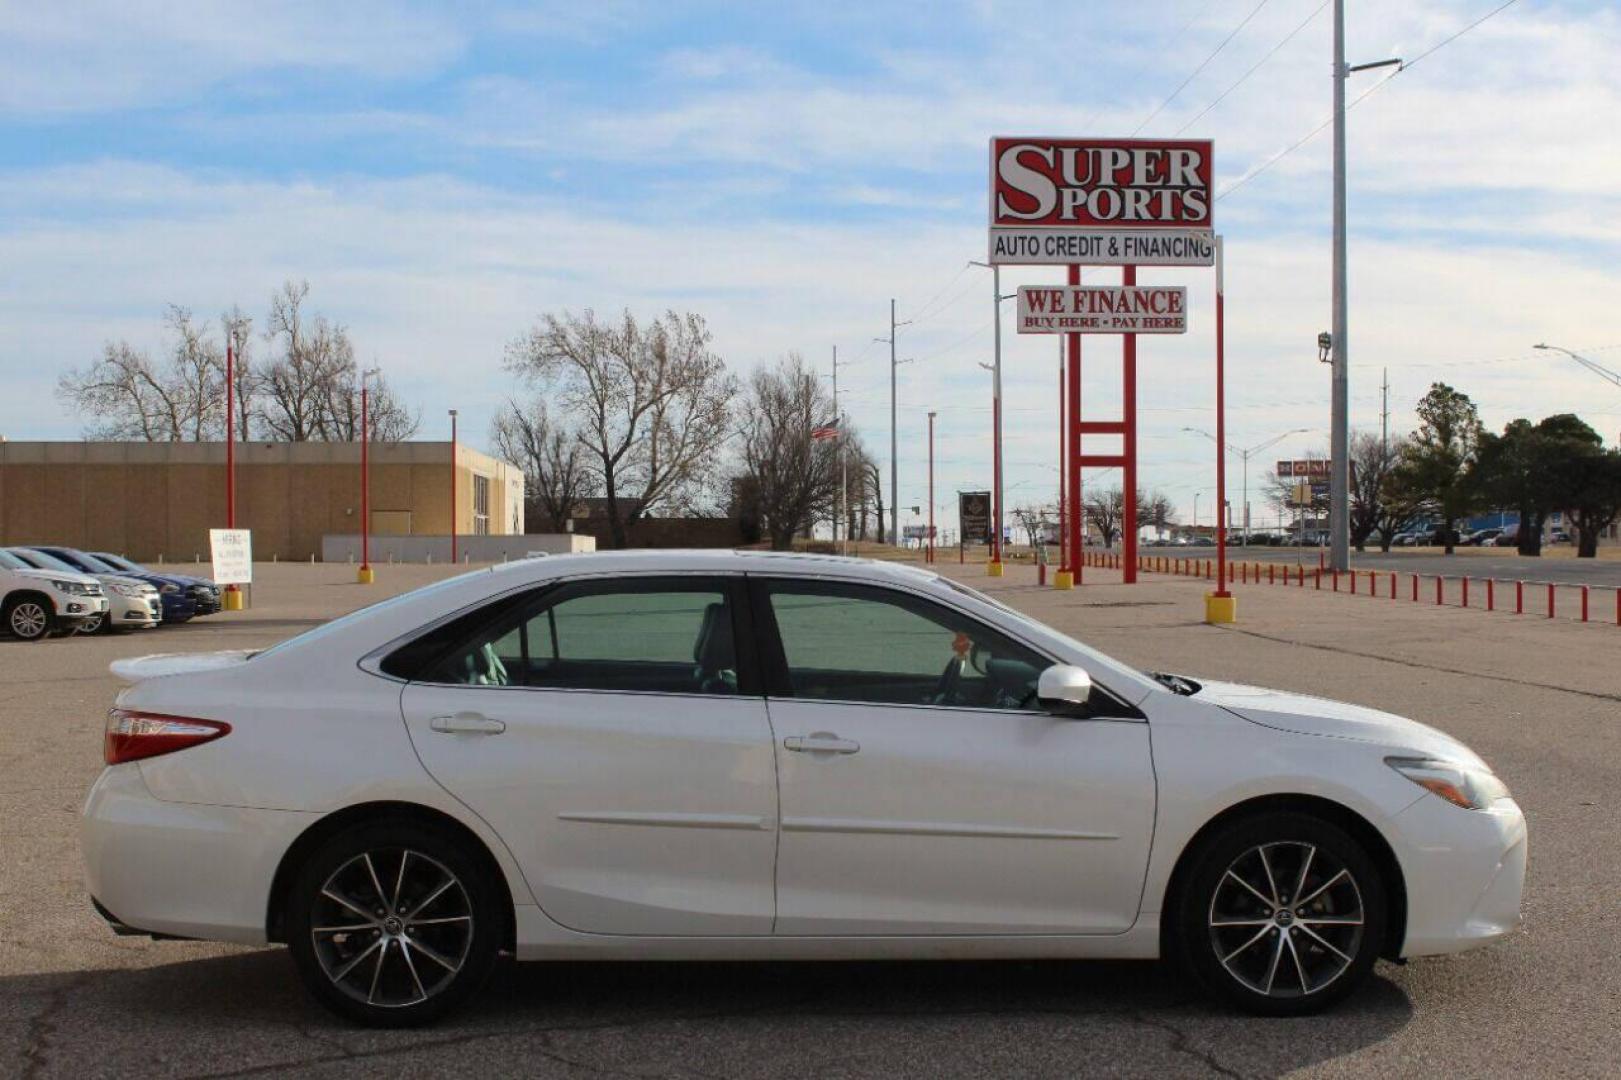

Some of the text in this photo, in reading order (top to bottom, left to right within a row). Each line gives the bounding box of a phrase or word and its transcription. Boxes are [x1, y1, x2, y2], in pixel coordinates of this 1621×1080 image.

[999, 144, 1205, 220] SUPER
[995, 236, 1212, 258] AUTO CREDIT & FINANCING
[1025, 290, 1183, 314] WE FINANCE
[1024, 316, 1184, 329] BUY HERE PAY HERE
